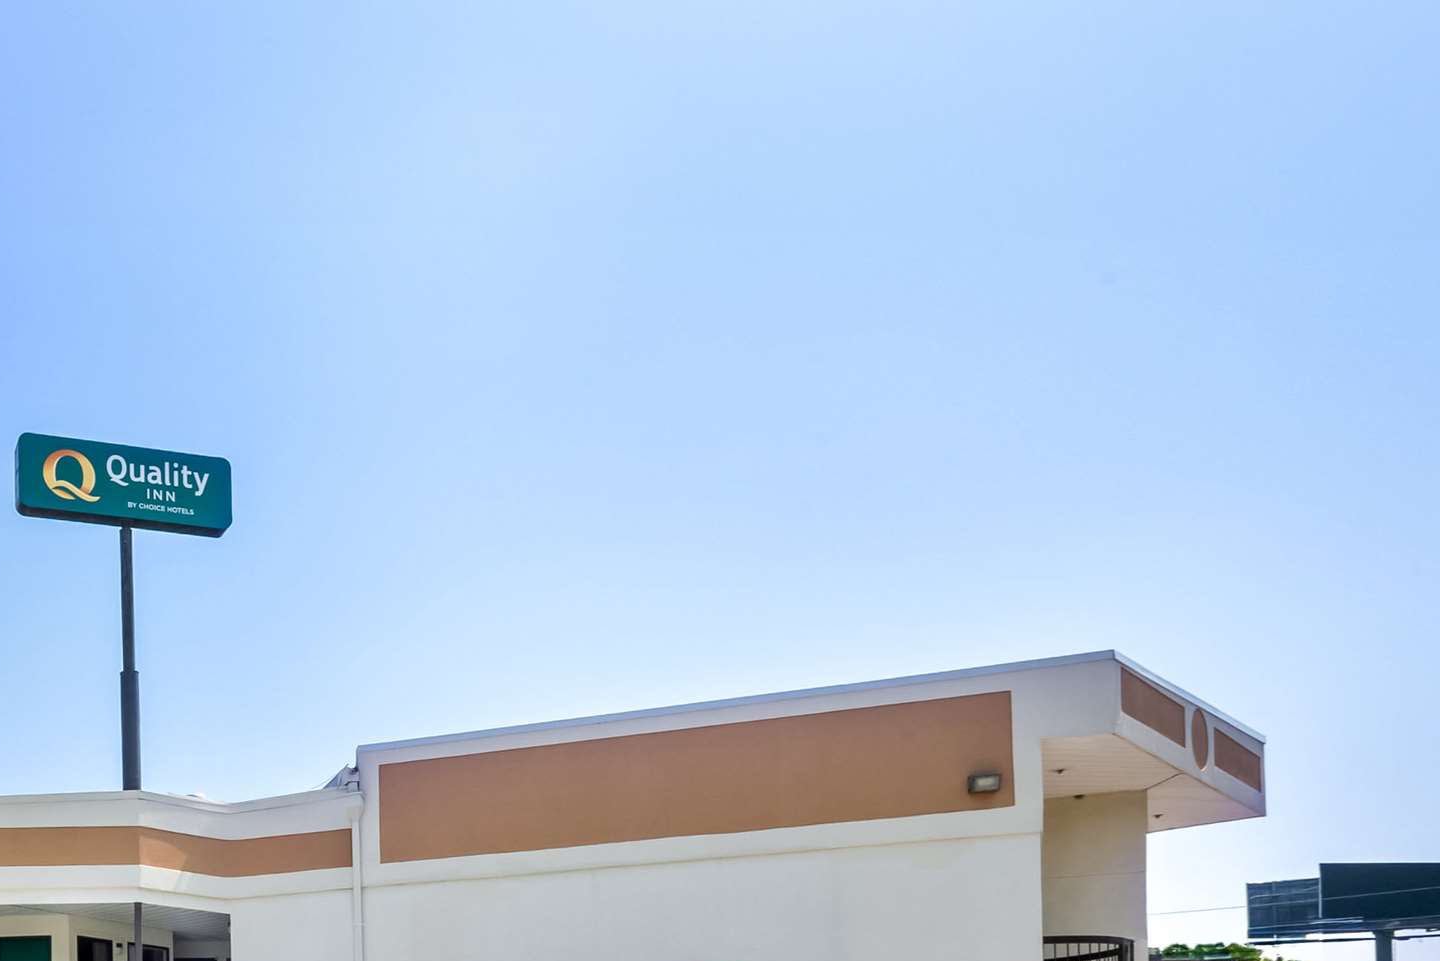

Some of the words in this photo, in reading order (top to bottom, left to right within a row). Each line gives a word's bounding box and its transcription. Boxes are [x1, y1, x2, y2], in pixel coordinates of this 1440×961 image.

[106, 454, 210, 496] Quality
[146, 487, 176, 502] INN
[138, 502, 166, 512] CHOICE
[166, 506, 195, 515] HOTELS
